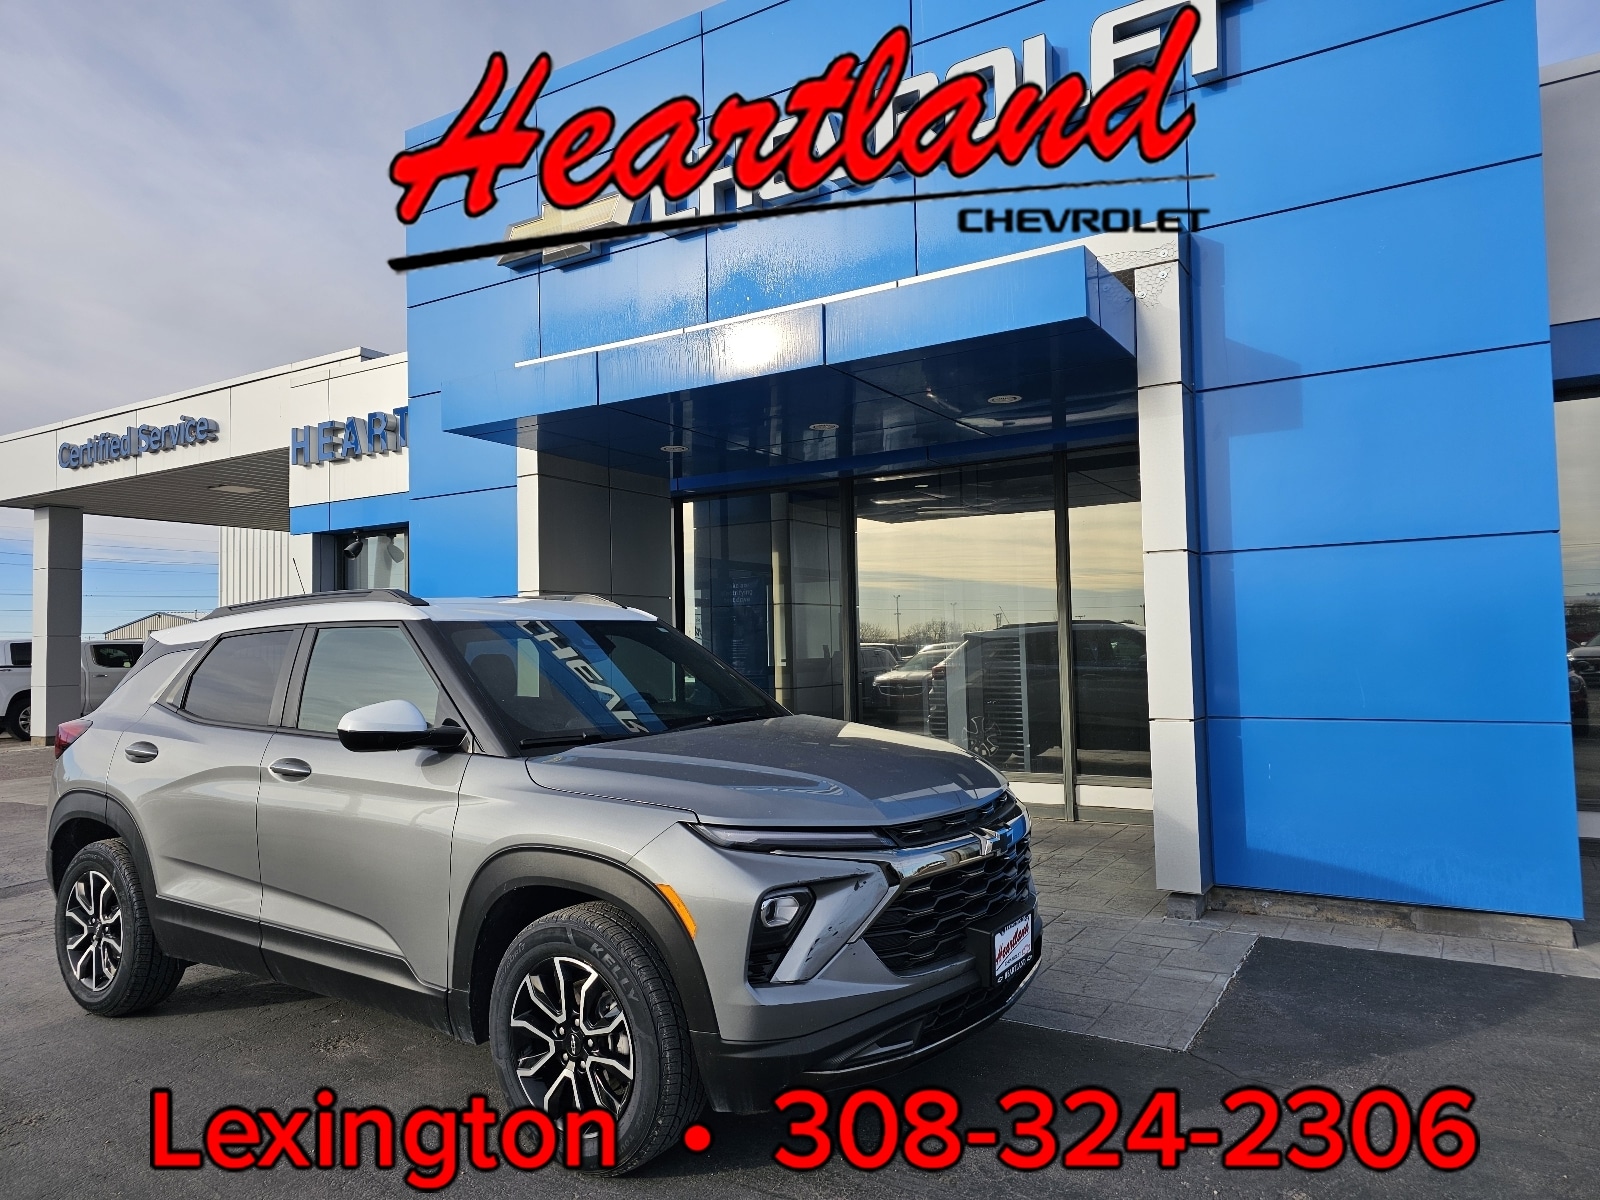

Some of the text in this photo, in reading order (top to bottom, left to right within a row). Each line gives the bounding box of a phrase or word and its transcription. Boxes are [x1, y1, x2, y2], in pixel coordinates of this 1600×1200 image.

[58, 414, 217, 469] Certified Service
[291, 406, 408, 466] HEART
[590, 942, 640, 1002] KELLY
